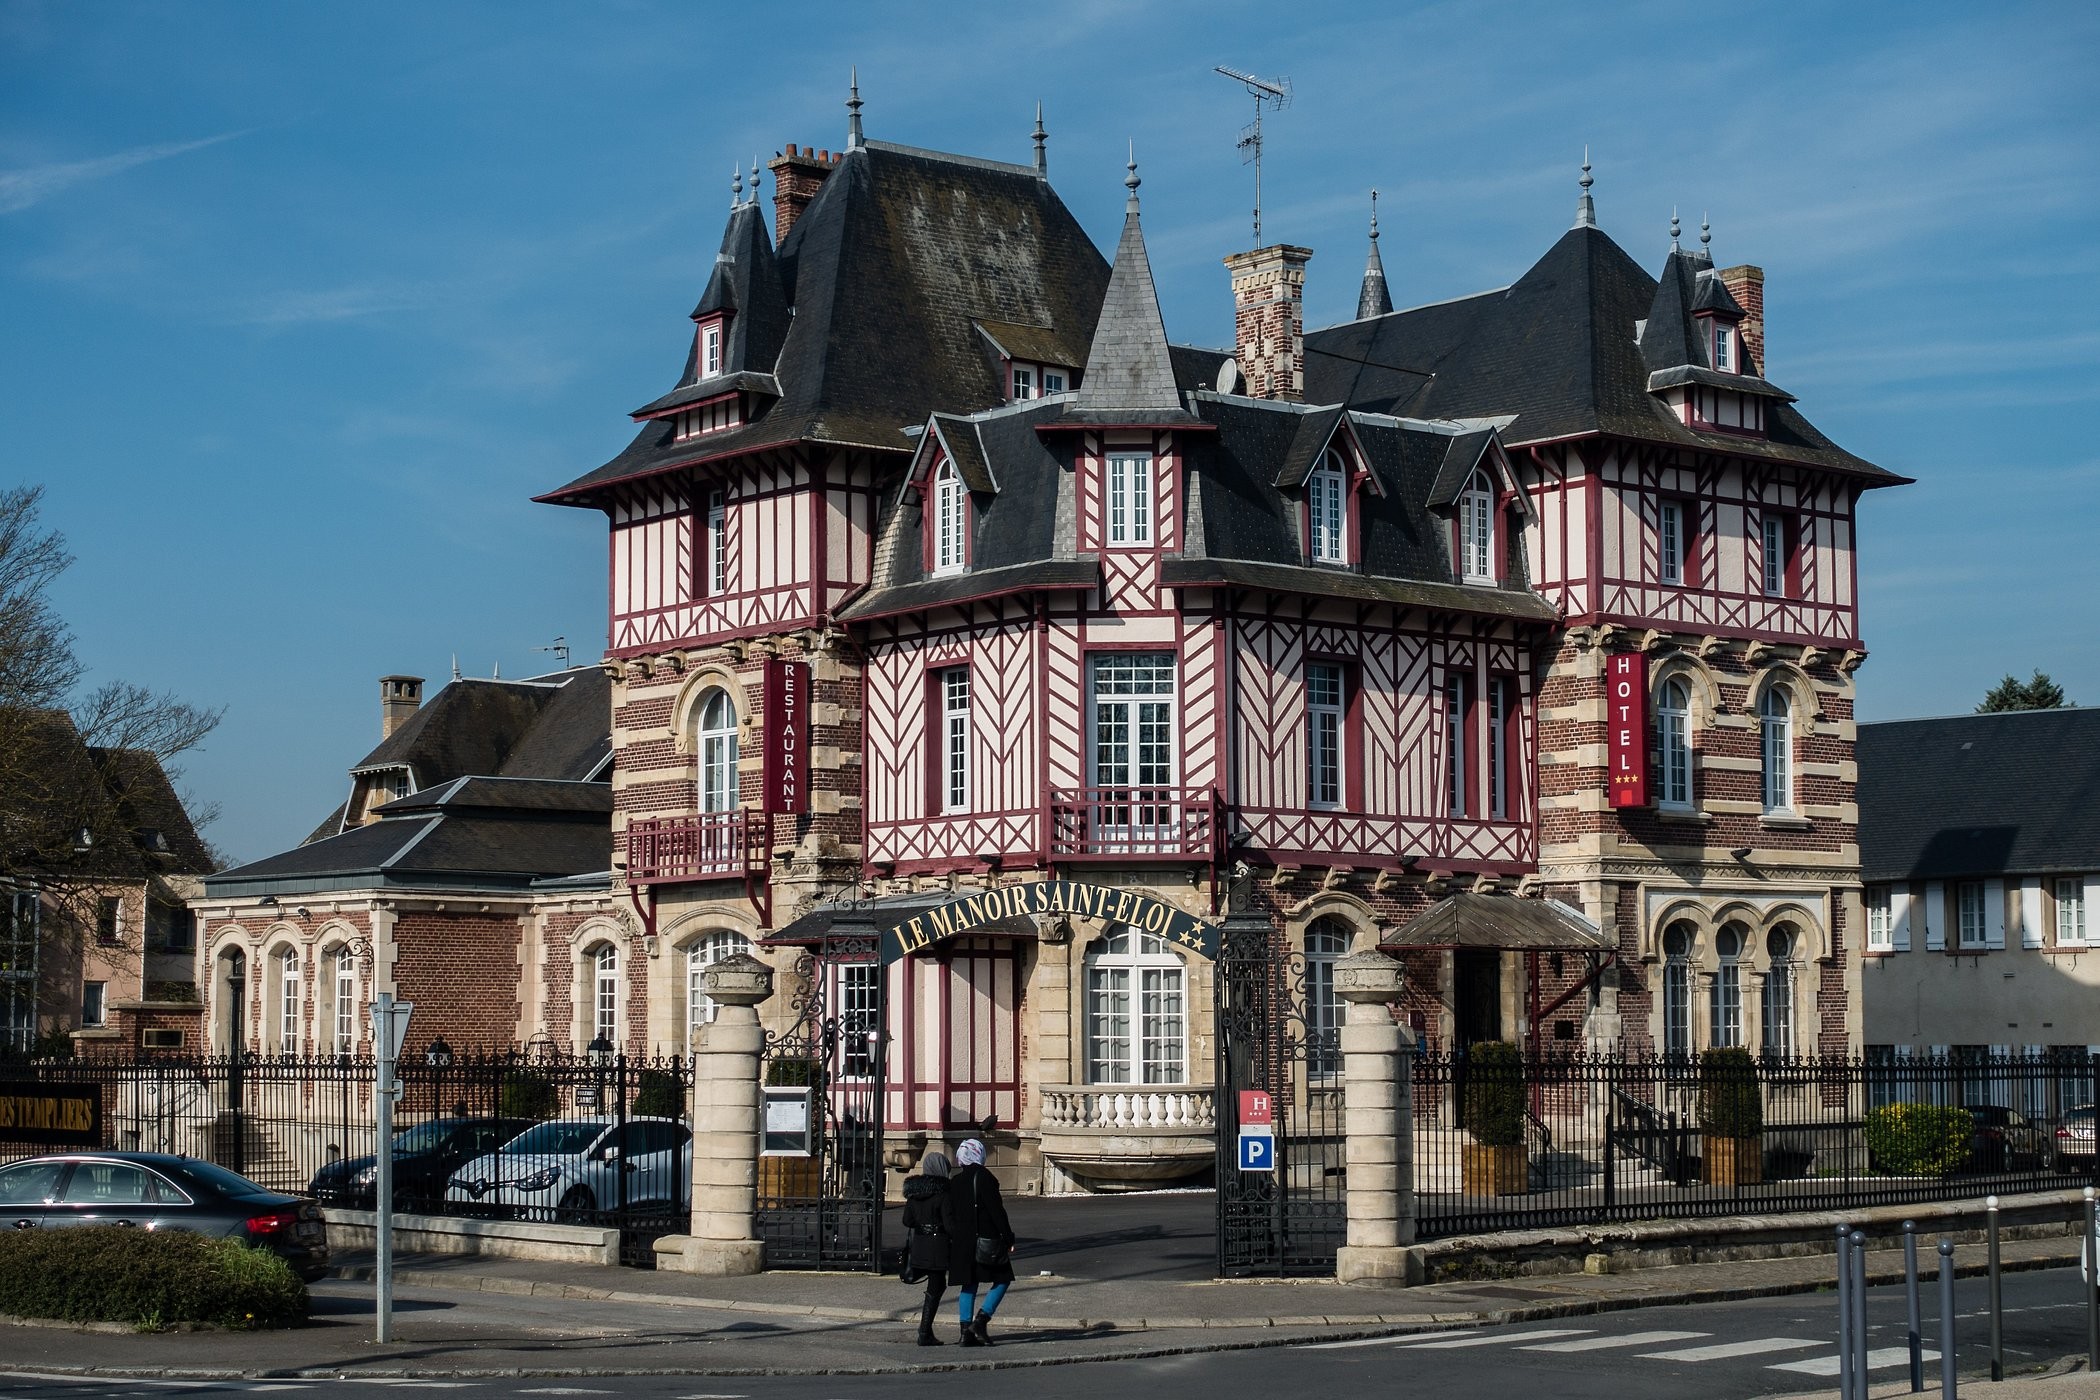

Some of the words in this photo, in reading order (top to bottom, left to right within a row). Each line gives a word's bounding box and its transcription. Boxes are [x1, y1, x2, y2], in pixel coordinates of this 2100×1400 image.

[783, 664, 795, 811] RESTAURANT
[1617, 657, 1631, 770] HOTEL
[893, 916, 932, 955] LE
[927, 885, 1033, 939] MANOIR
[1035, 882, 1177, 938] SAINT-ELOI
[16, 1096, 92, 1131] TEMPLIERS
[1253, 1097, 1268, 1111] H
[1248, 1141, 1264, 1163] P
